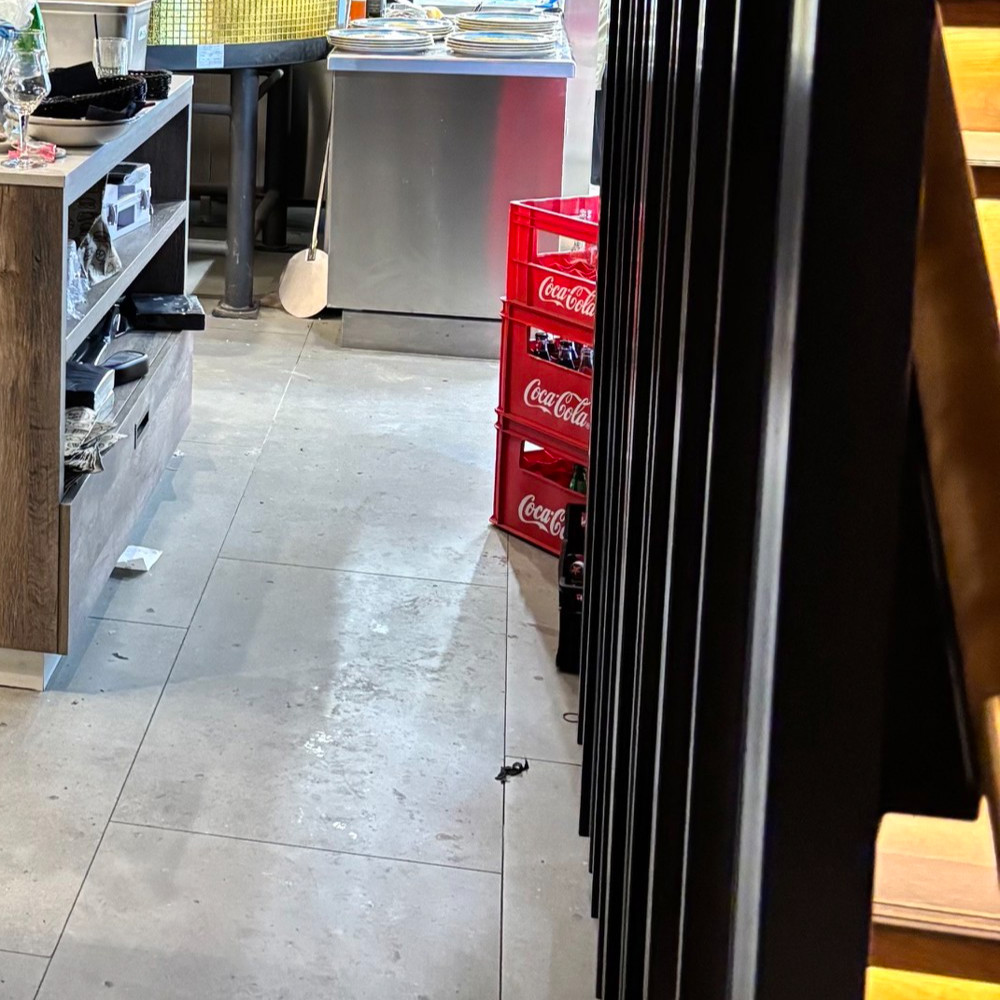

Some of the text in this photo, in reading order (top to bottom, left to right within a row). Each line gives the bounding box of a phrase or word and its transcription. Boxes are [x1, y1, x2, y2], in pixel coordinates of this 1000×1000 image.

[538, 275, 597, 317] Coca-Cola
[523, 378, 591, 428] Coca-Cola
[518, 494, 566, 540] Coca-C
